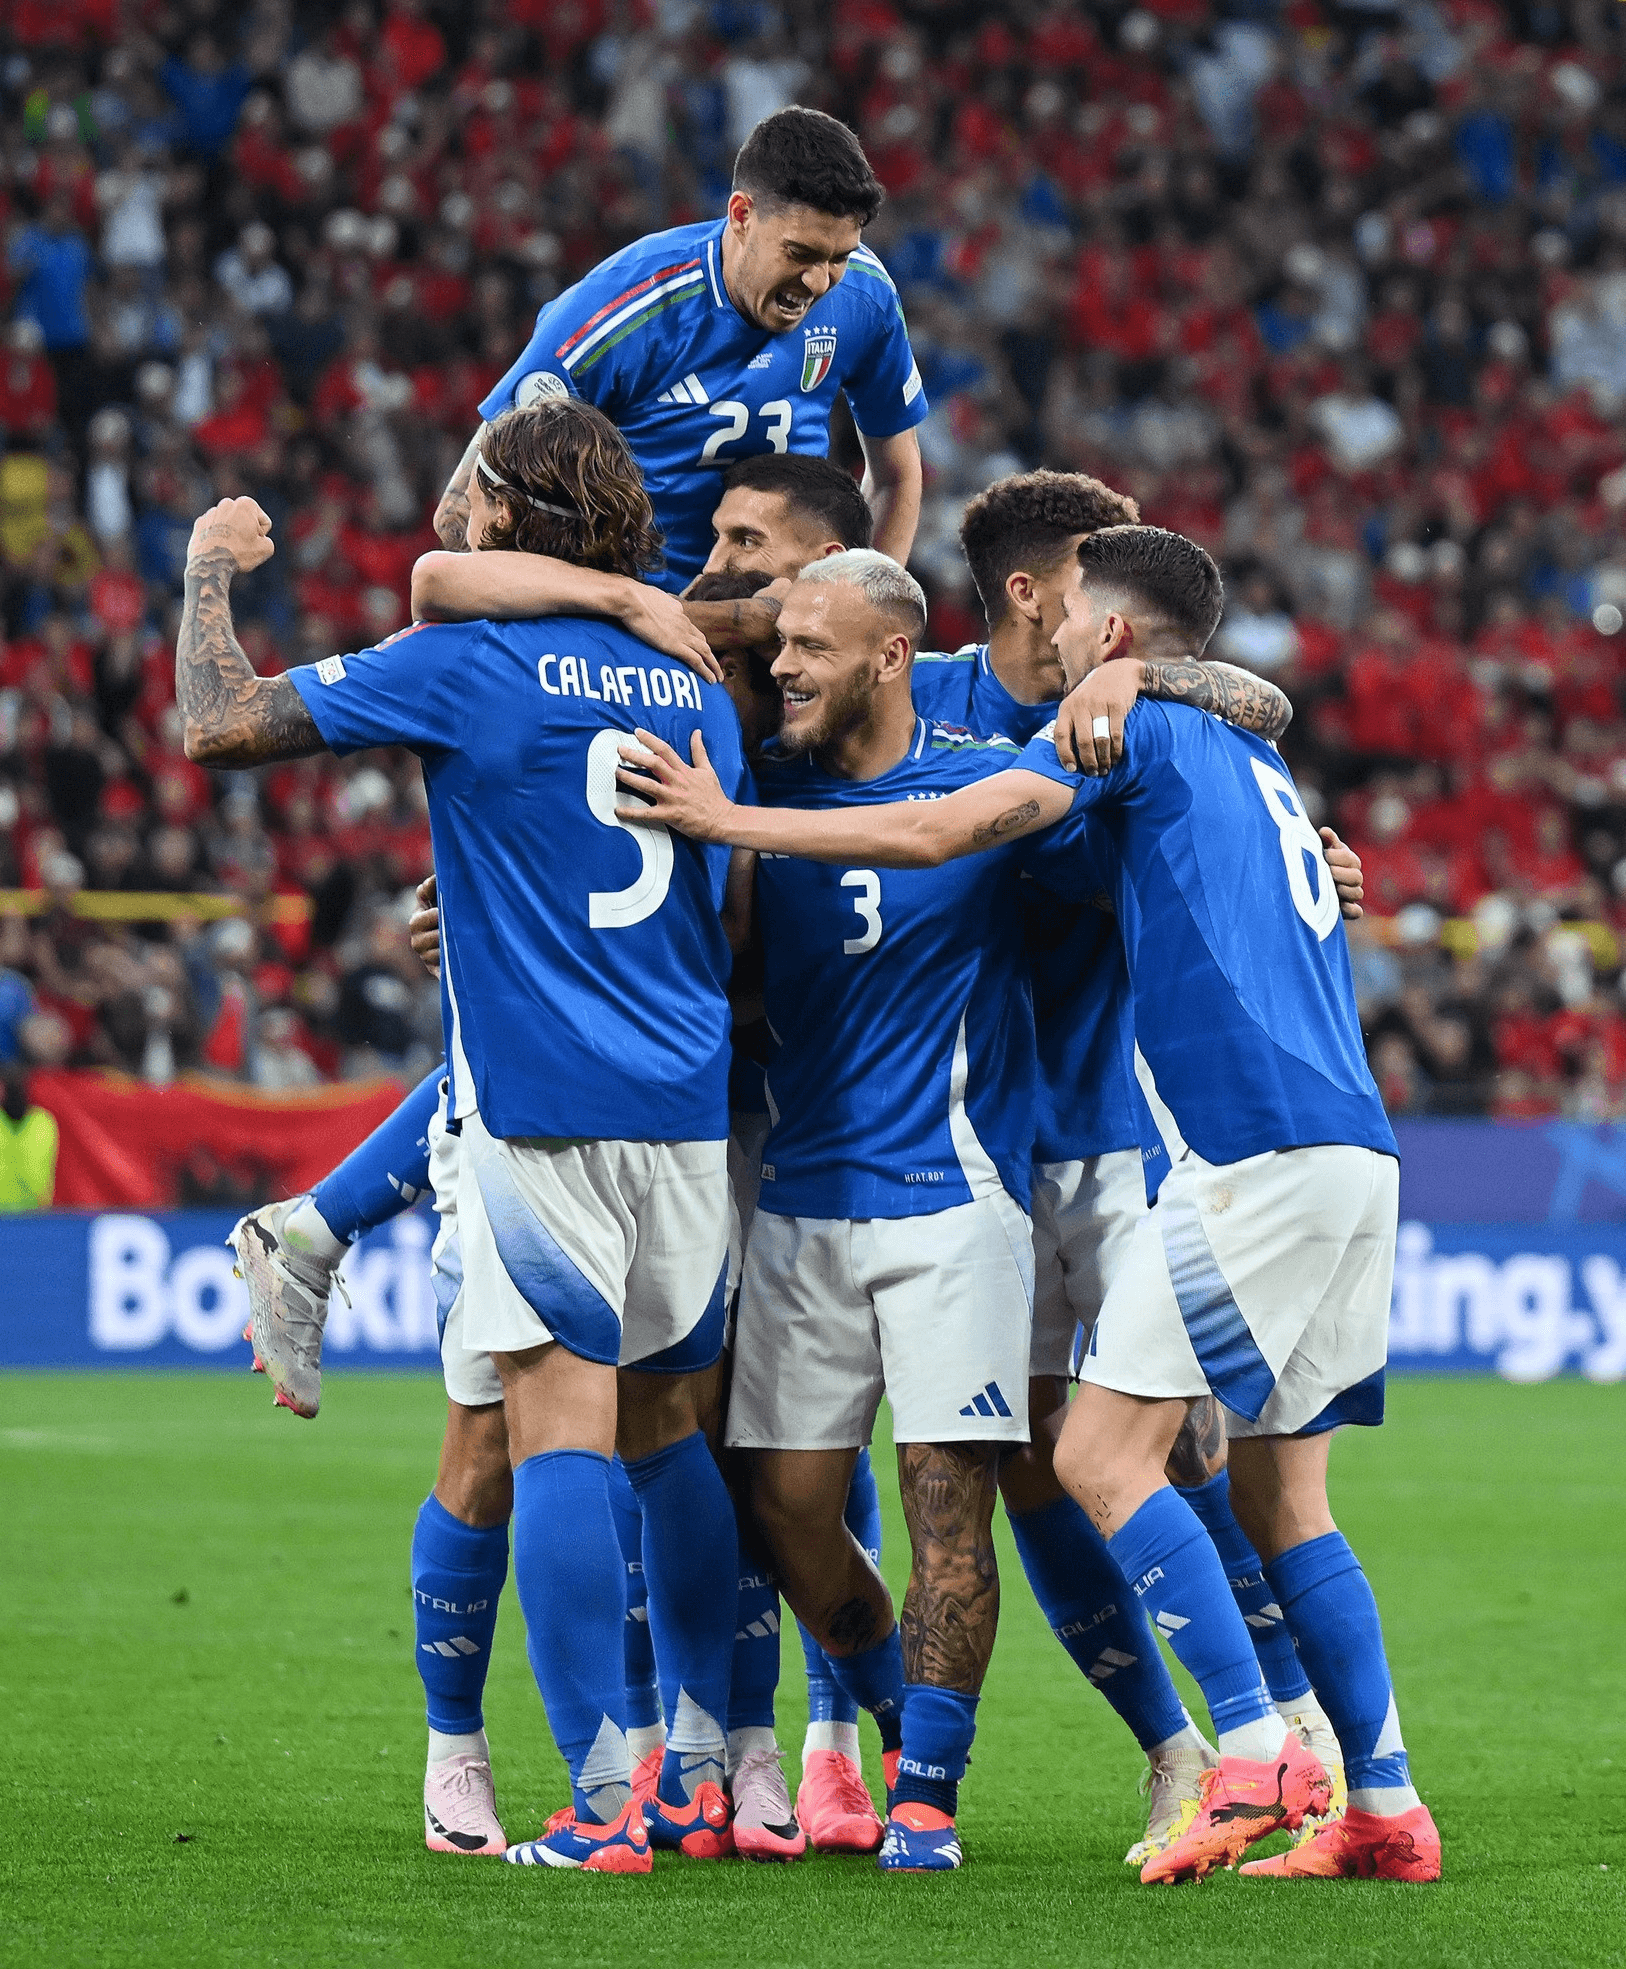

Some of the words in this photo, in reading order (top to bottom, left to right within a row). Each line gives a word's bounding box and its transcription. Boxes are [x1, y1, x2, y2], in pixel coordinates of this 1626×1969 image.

[808, 341, 833, 355] ITALIA
[696, 399, 792, 467] 23
[537, 653, 703, 712] CALAFIORI
[1249, 755, 1340, 942] 8
[840, 869, 883, 955] 3
[90, 1215, 438, 1352] Boki
[1390, 1221, 1626, 1383] ing.y
[898, 1756, 946, 1780] TALIA
